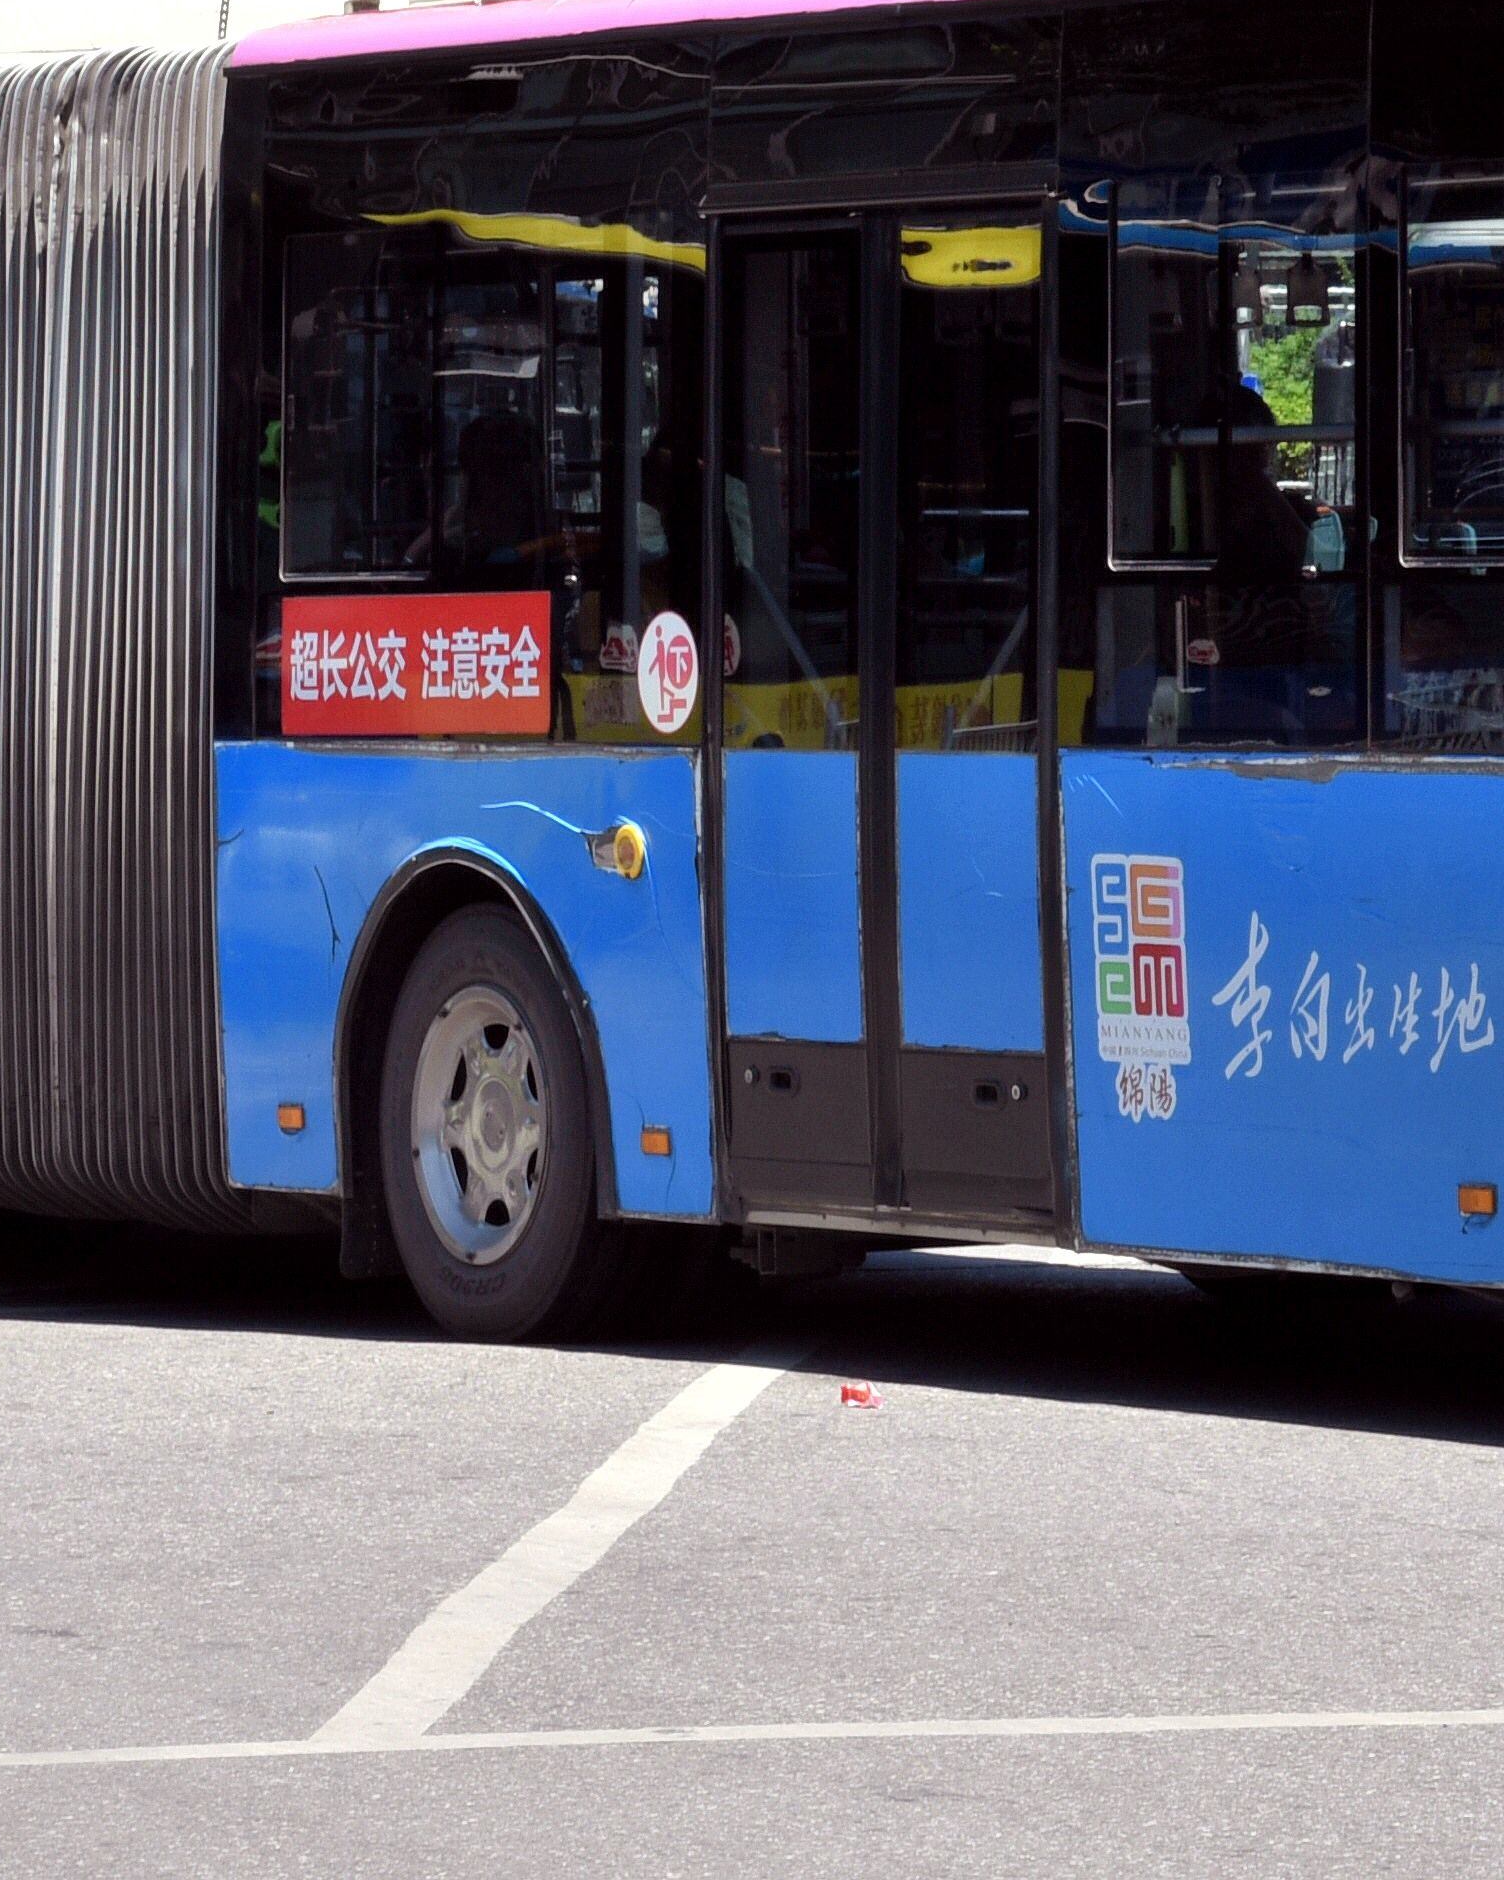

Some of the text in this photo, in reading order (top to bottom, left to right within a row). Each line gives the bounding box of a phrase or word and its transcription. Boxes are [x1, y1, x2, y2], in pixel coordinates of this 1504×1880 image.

[290, 624, 541, 702] 超长公交 注意安全
[668, 645, 692, 683] 下
[1211, 910, 1495, 1081] 李白出生地
[1100, 1023, 1188, 1044] MIANYANG
